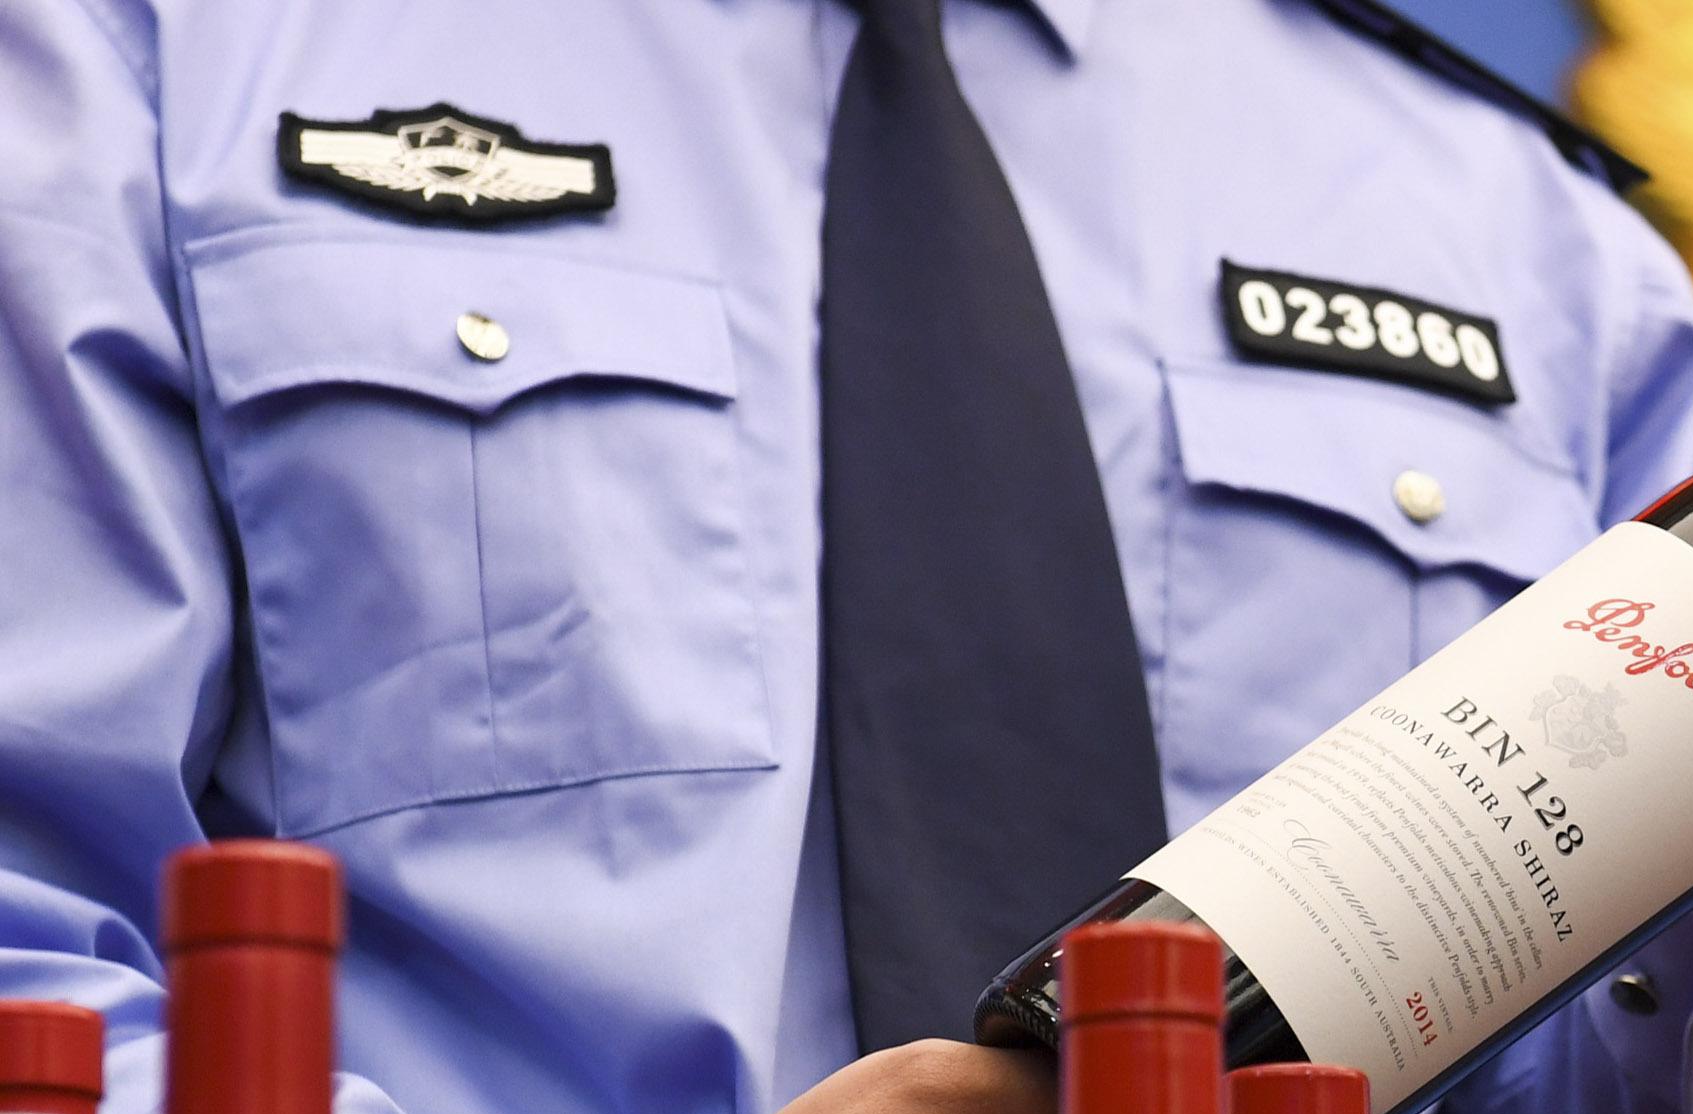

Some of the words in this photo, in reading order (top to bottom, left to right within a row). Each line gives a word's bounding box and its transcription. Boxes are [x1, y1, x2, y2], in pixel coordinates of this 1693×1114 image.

[1238, 281, 1499, 382] 023860
[1371, 704, 1513, 832] COONAWARRA
[1512, 838, 1573, 942] SHIRAZ
[1440, 695, 1526, 770] BIN
[1515, 772, 1585, 859] 128
[1356, 830, 1398, 874] characters
[1394, 872, 1406, 884] to
[1402, 883, 1419, 900] the
[1414, 901, 1452, 953] distinctive
[1446, 952, 1473, 996] Penfolds
[1382, 830, 1423, 873] premium
[1421, 873, 1458, 926] vineyards,
[1454, 924, 1466, 937] in
[1462, 937, 1480, 964] order
[1474, 964, 1484, 976] to
[1391, 806, 1428, 844] Penfolds
[1423, 843, 1462, 893] meticulous
[1459, 892, 1496, 955] winemaking
[1489, 952, 1513, 992] approach
[1404, 791, 1430, 816] wines
[1427, 815, 1449, 838] were
[1445, 838, 1474, 871] stored.
[1468, 868, 1484, 887] The
[1480, 888, 1514, 937] renowned
[1505, 936, 1518, 957] Bin
[1437, 799, 1466, 829] system
[1462, 828, 1479, 839] of
[1471, 839, 1511, 889] numbered
[1516, 913, 1526, 926] in
[1521, 925, 1534, 941] the
[1265, 865, 1330, 934] ESTABLISHED
[1329, 936, 1352, 964] 1844
[1349, 966, 1378, 1007] SOUTH
[1373, 1009, 1405, 1071] AUSTRALIA
[1404, 990, 1438, 1047] 2014
